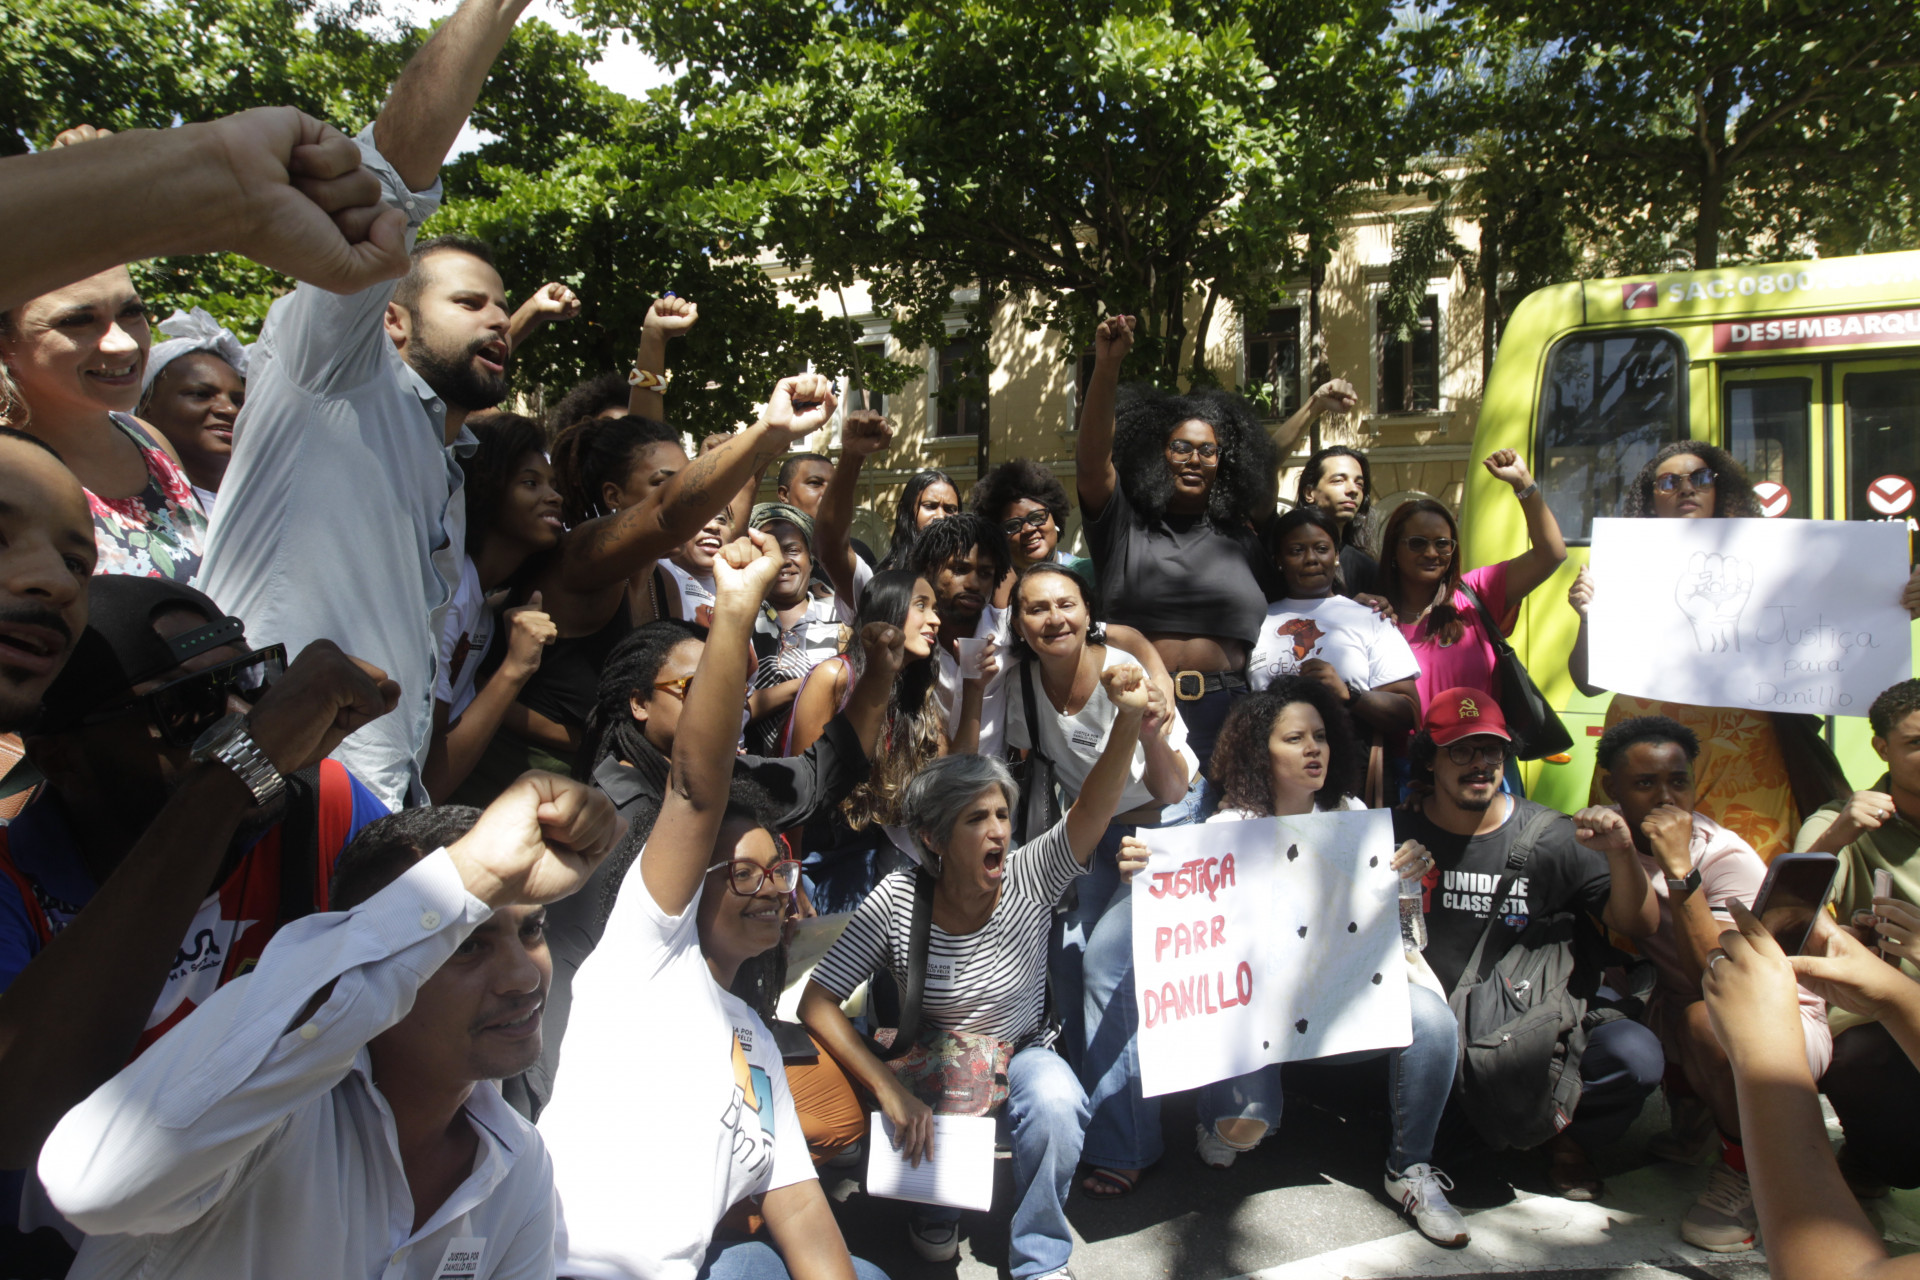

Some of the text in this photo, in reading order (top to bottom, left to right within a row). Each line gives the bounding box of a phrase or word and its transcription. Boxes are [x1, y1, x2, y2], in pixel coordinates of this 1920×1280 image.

[1755, 605, 1880, 655] Justiça
[1783, 659, 1845, 679] para
[1748, 682, 1853, 708] Danillo
[1459, 710, 1480, 719] PCB
[1443, 892, 1529, 915] CLASSSTA
[1143, 961, 1252, 1029] DANILLO
[740, 1028, 753, 1036] POR
[448, 1251, 470, 1263] JUSTIÇA
